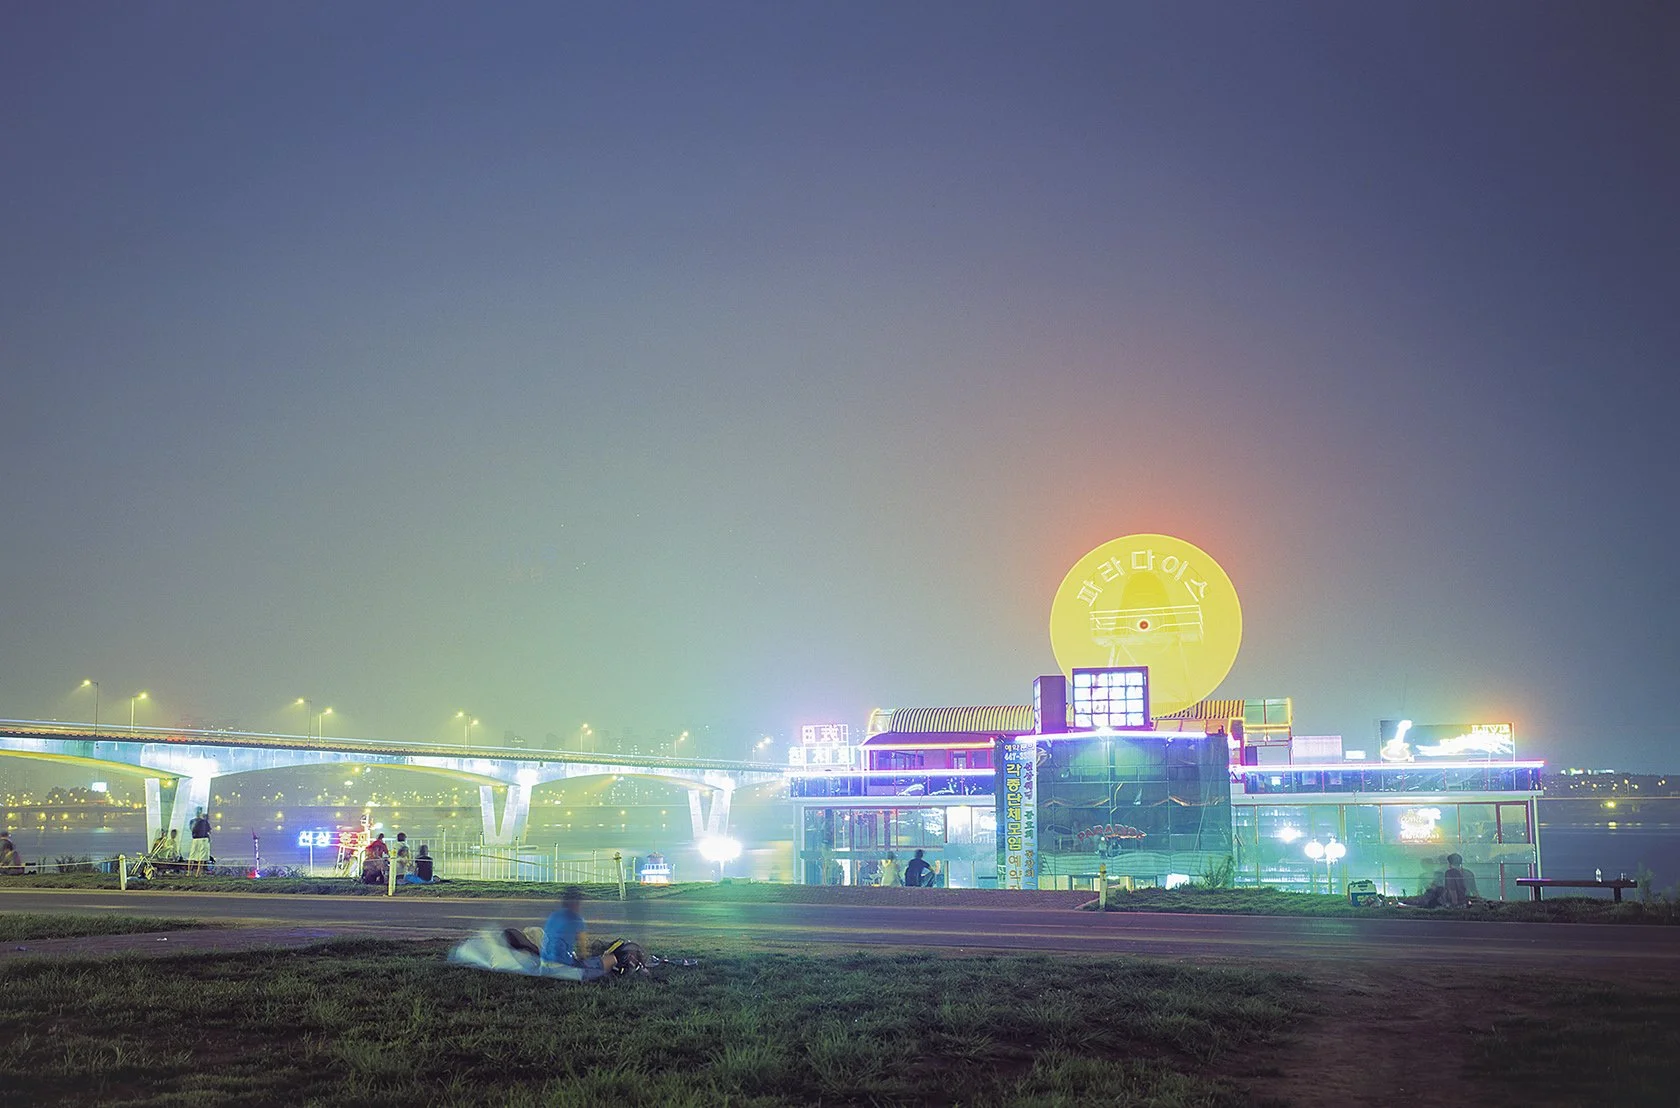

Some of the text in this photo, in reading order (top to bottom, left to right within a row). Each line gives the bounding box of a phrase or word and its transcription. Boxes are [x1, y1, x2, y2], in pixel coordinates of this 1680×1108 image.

[1077, 550, 1208, 607] 파라다이스
[1472, 724, 1510, 734] LIVE
[1006, 763, 1022, 851] 각종단체모임
